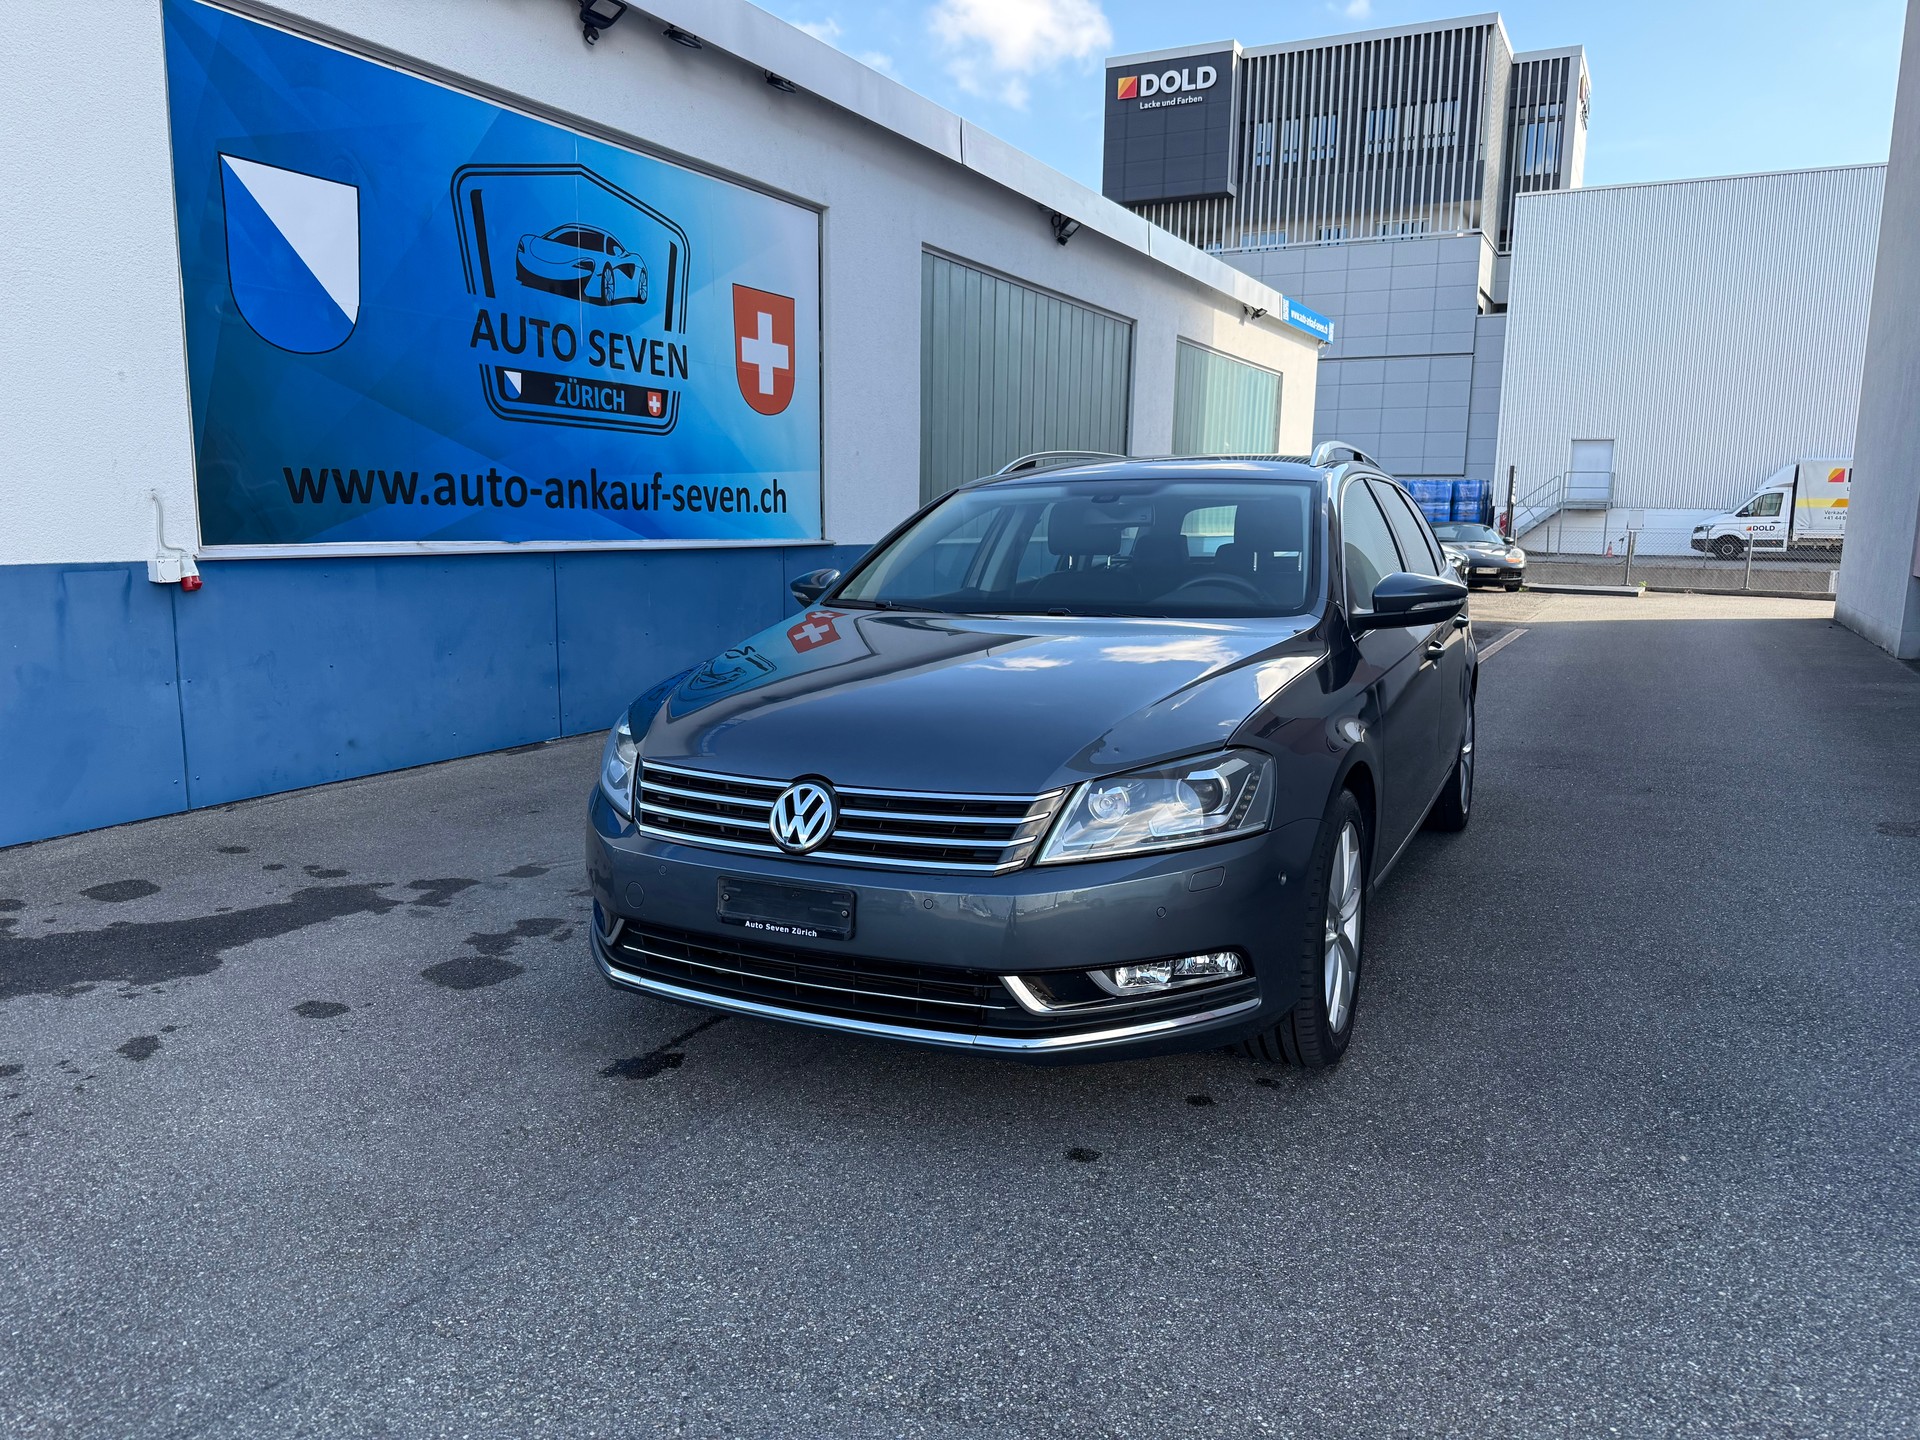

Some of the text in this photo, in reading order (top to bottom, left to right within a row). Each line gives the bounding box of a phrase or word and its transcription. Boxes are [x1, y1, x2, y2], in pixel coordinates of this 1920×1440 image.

[1140, 65, 1217, 97] DOLD
[1139, 95, 1203, 110] Lacke und Farben
[470, 308, 688, 380] AUTO SEVEN
[554, 378, 626, 412] ZÜRICH
[282, 466, 788, 514] www.auto-ankauf-seven.ch
[745, 920, 817, 937] Auto Seven Zürich
